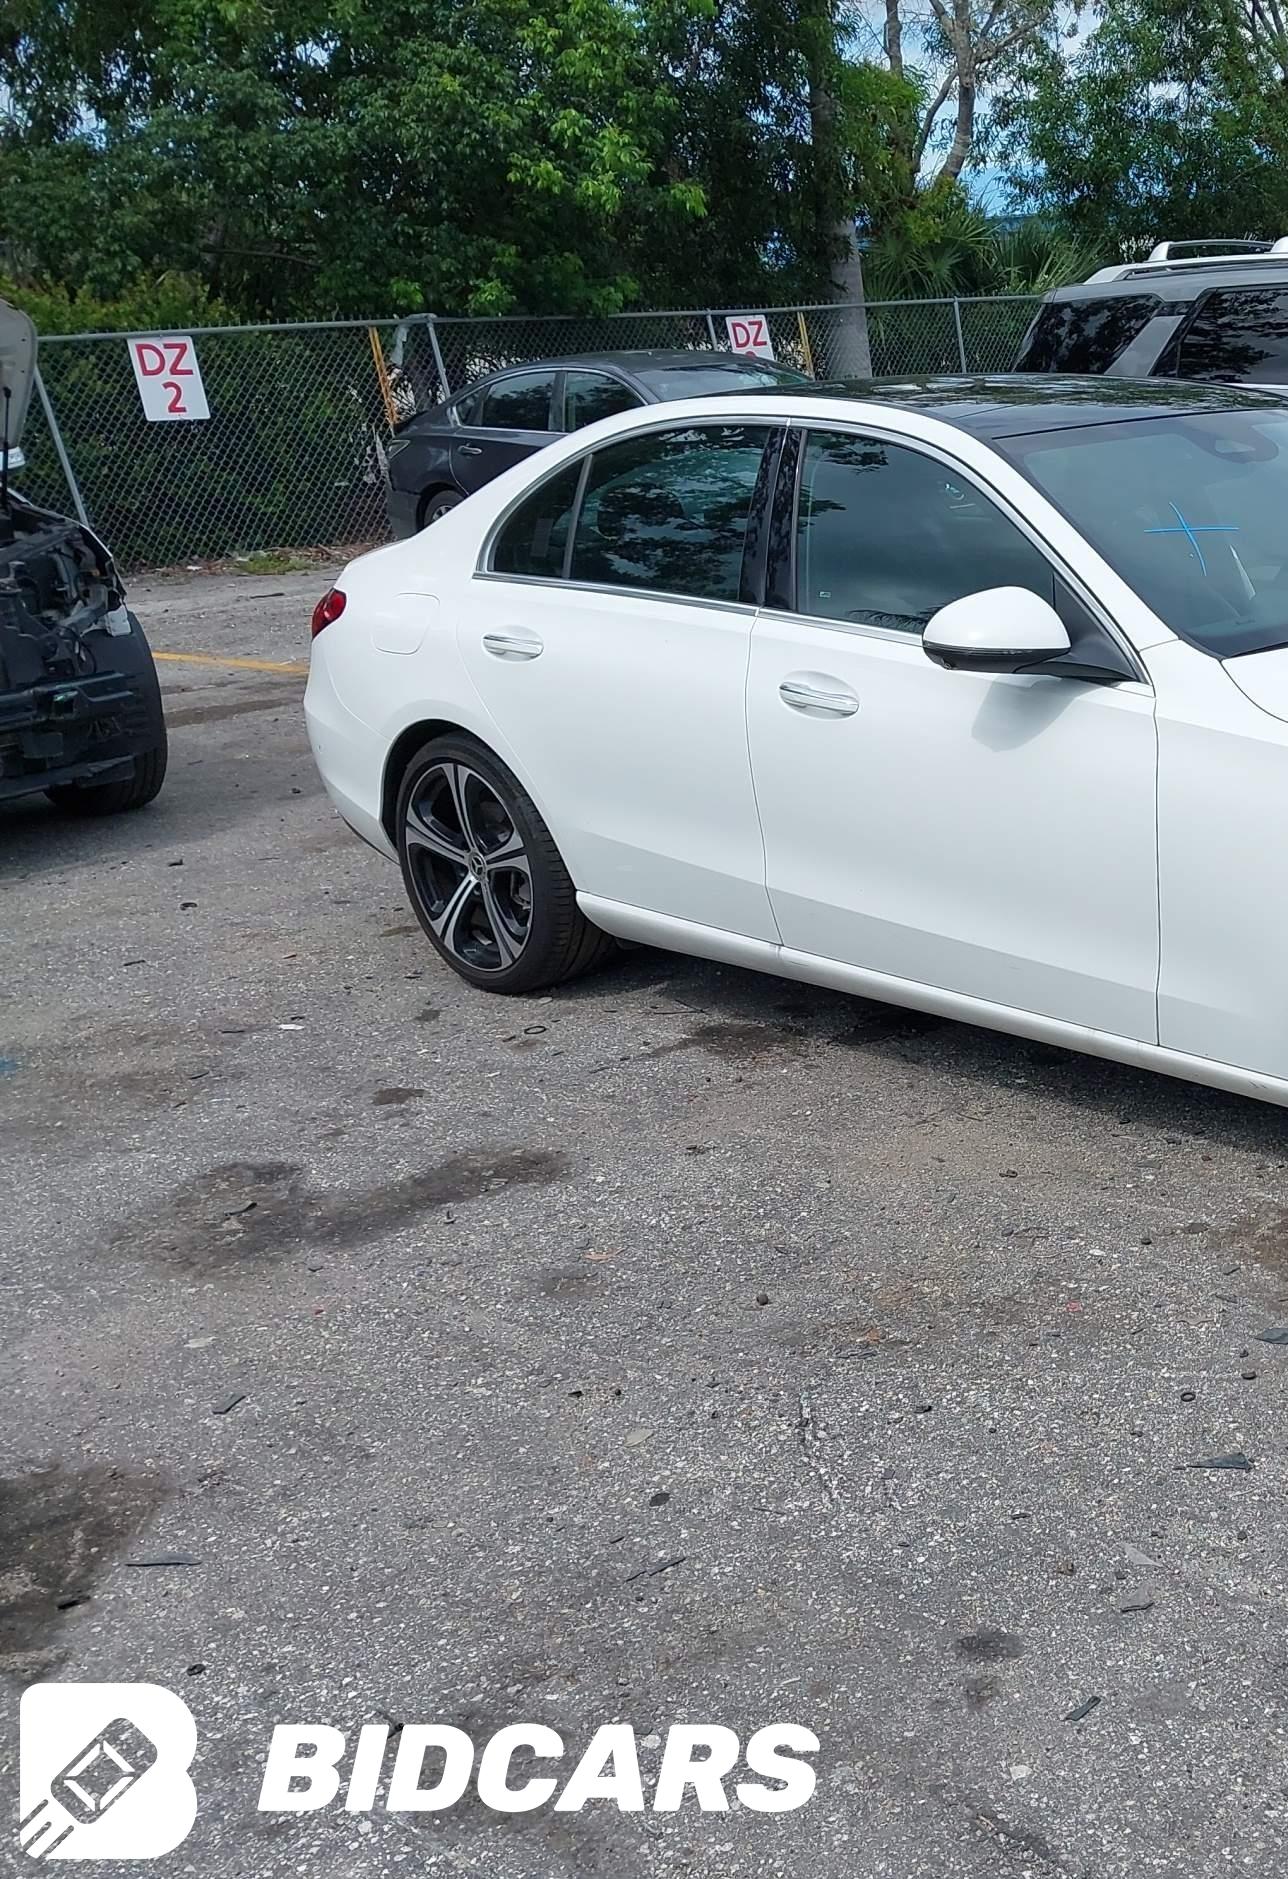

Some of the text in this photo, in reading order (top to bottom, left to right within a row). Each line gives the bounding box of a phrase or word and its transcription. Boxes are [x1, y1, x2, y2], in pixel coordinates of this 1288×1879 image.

[731, 320, 768, 348] DZ
[134, 342, 194, 376] DZ
[161, 381, 187, 413] 2
